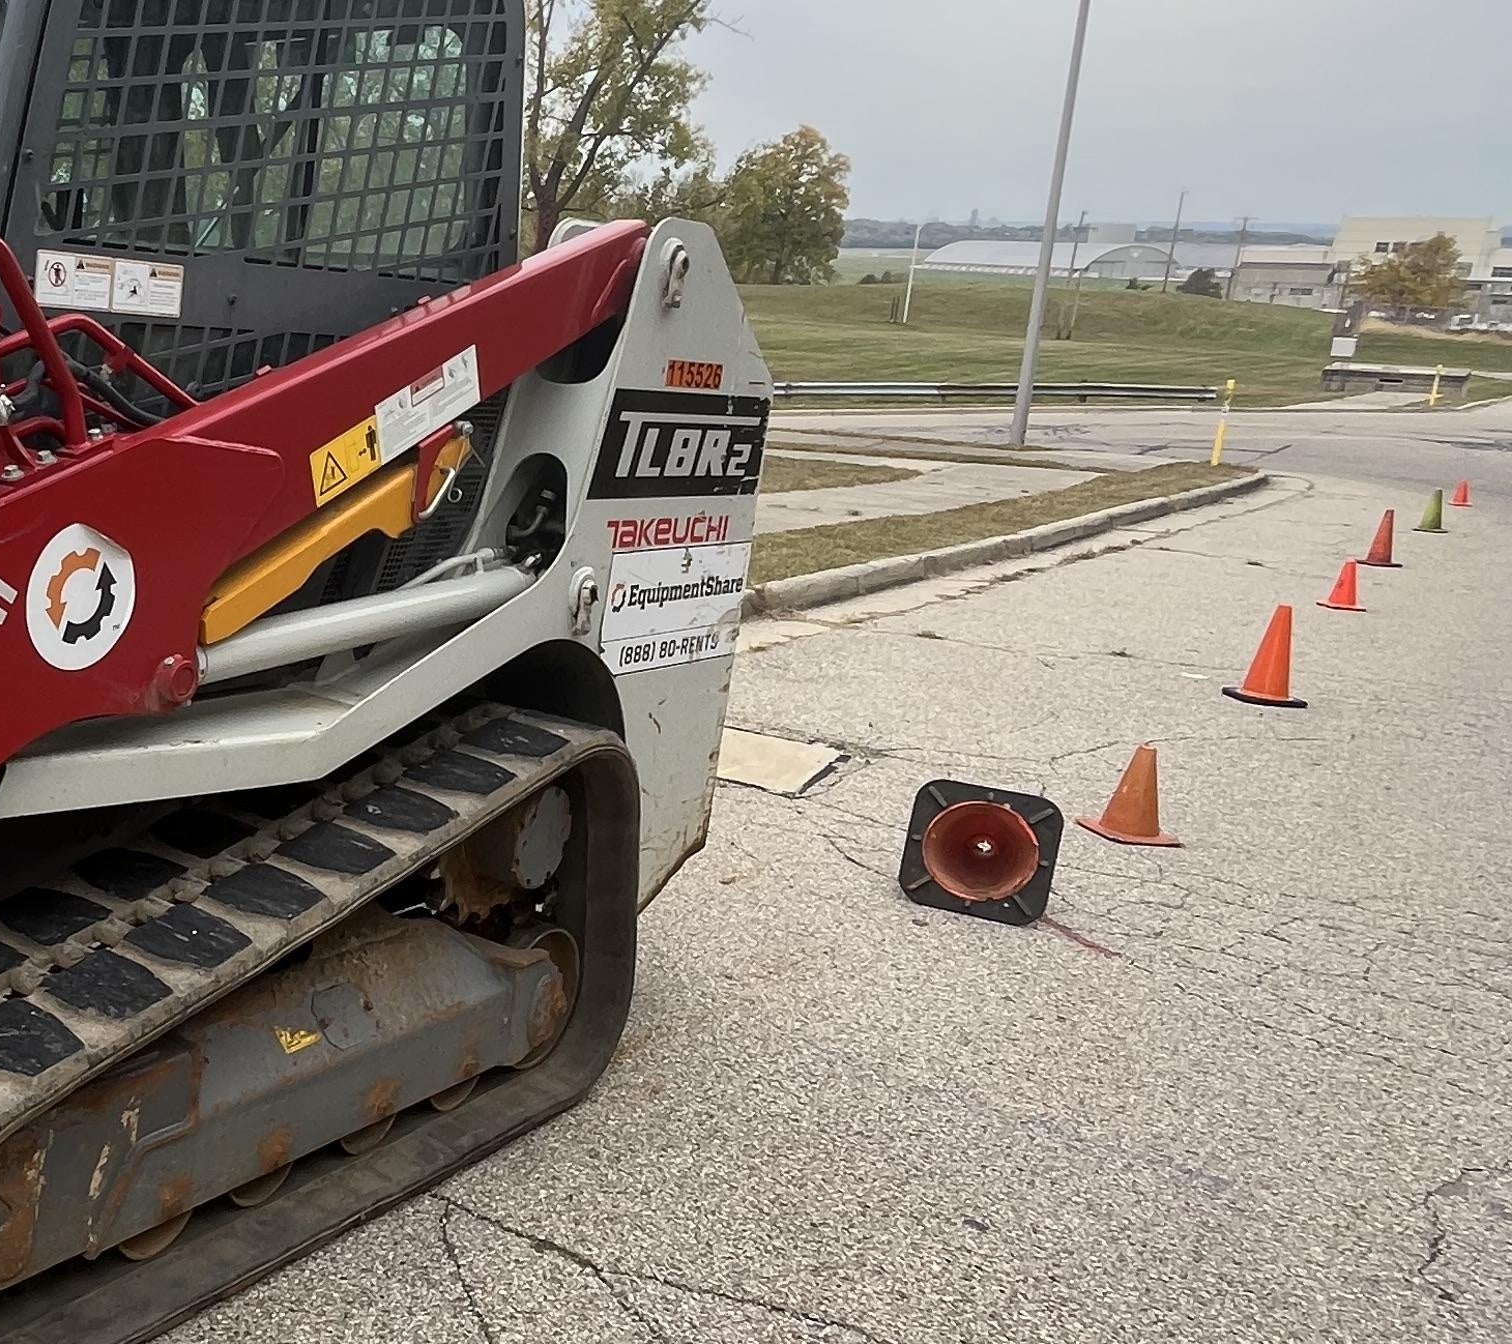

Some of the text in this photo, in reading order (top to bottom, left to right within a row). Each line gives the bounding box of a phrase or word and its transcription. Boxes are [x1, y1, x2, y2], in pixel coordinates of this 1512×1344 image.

[667, 360, 724, 389] 115526
[627, 575, 744, 610] EquipmentShare
[618, 632, 719, 667] (888) 80-RENTS
